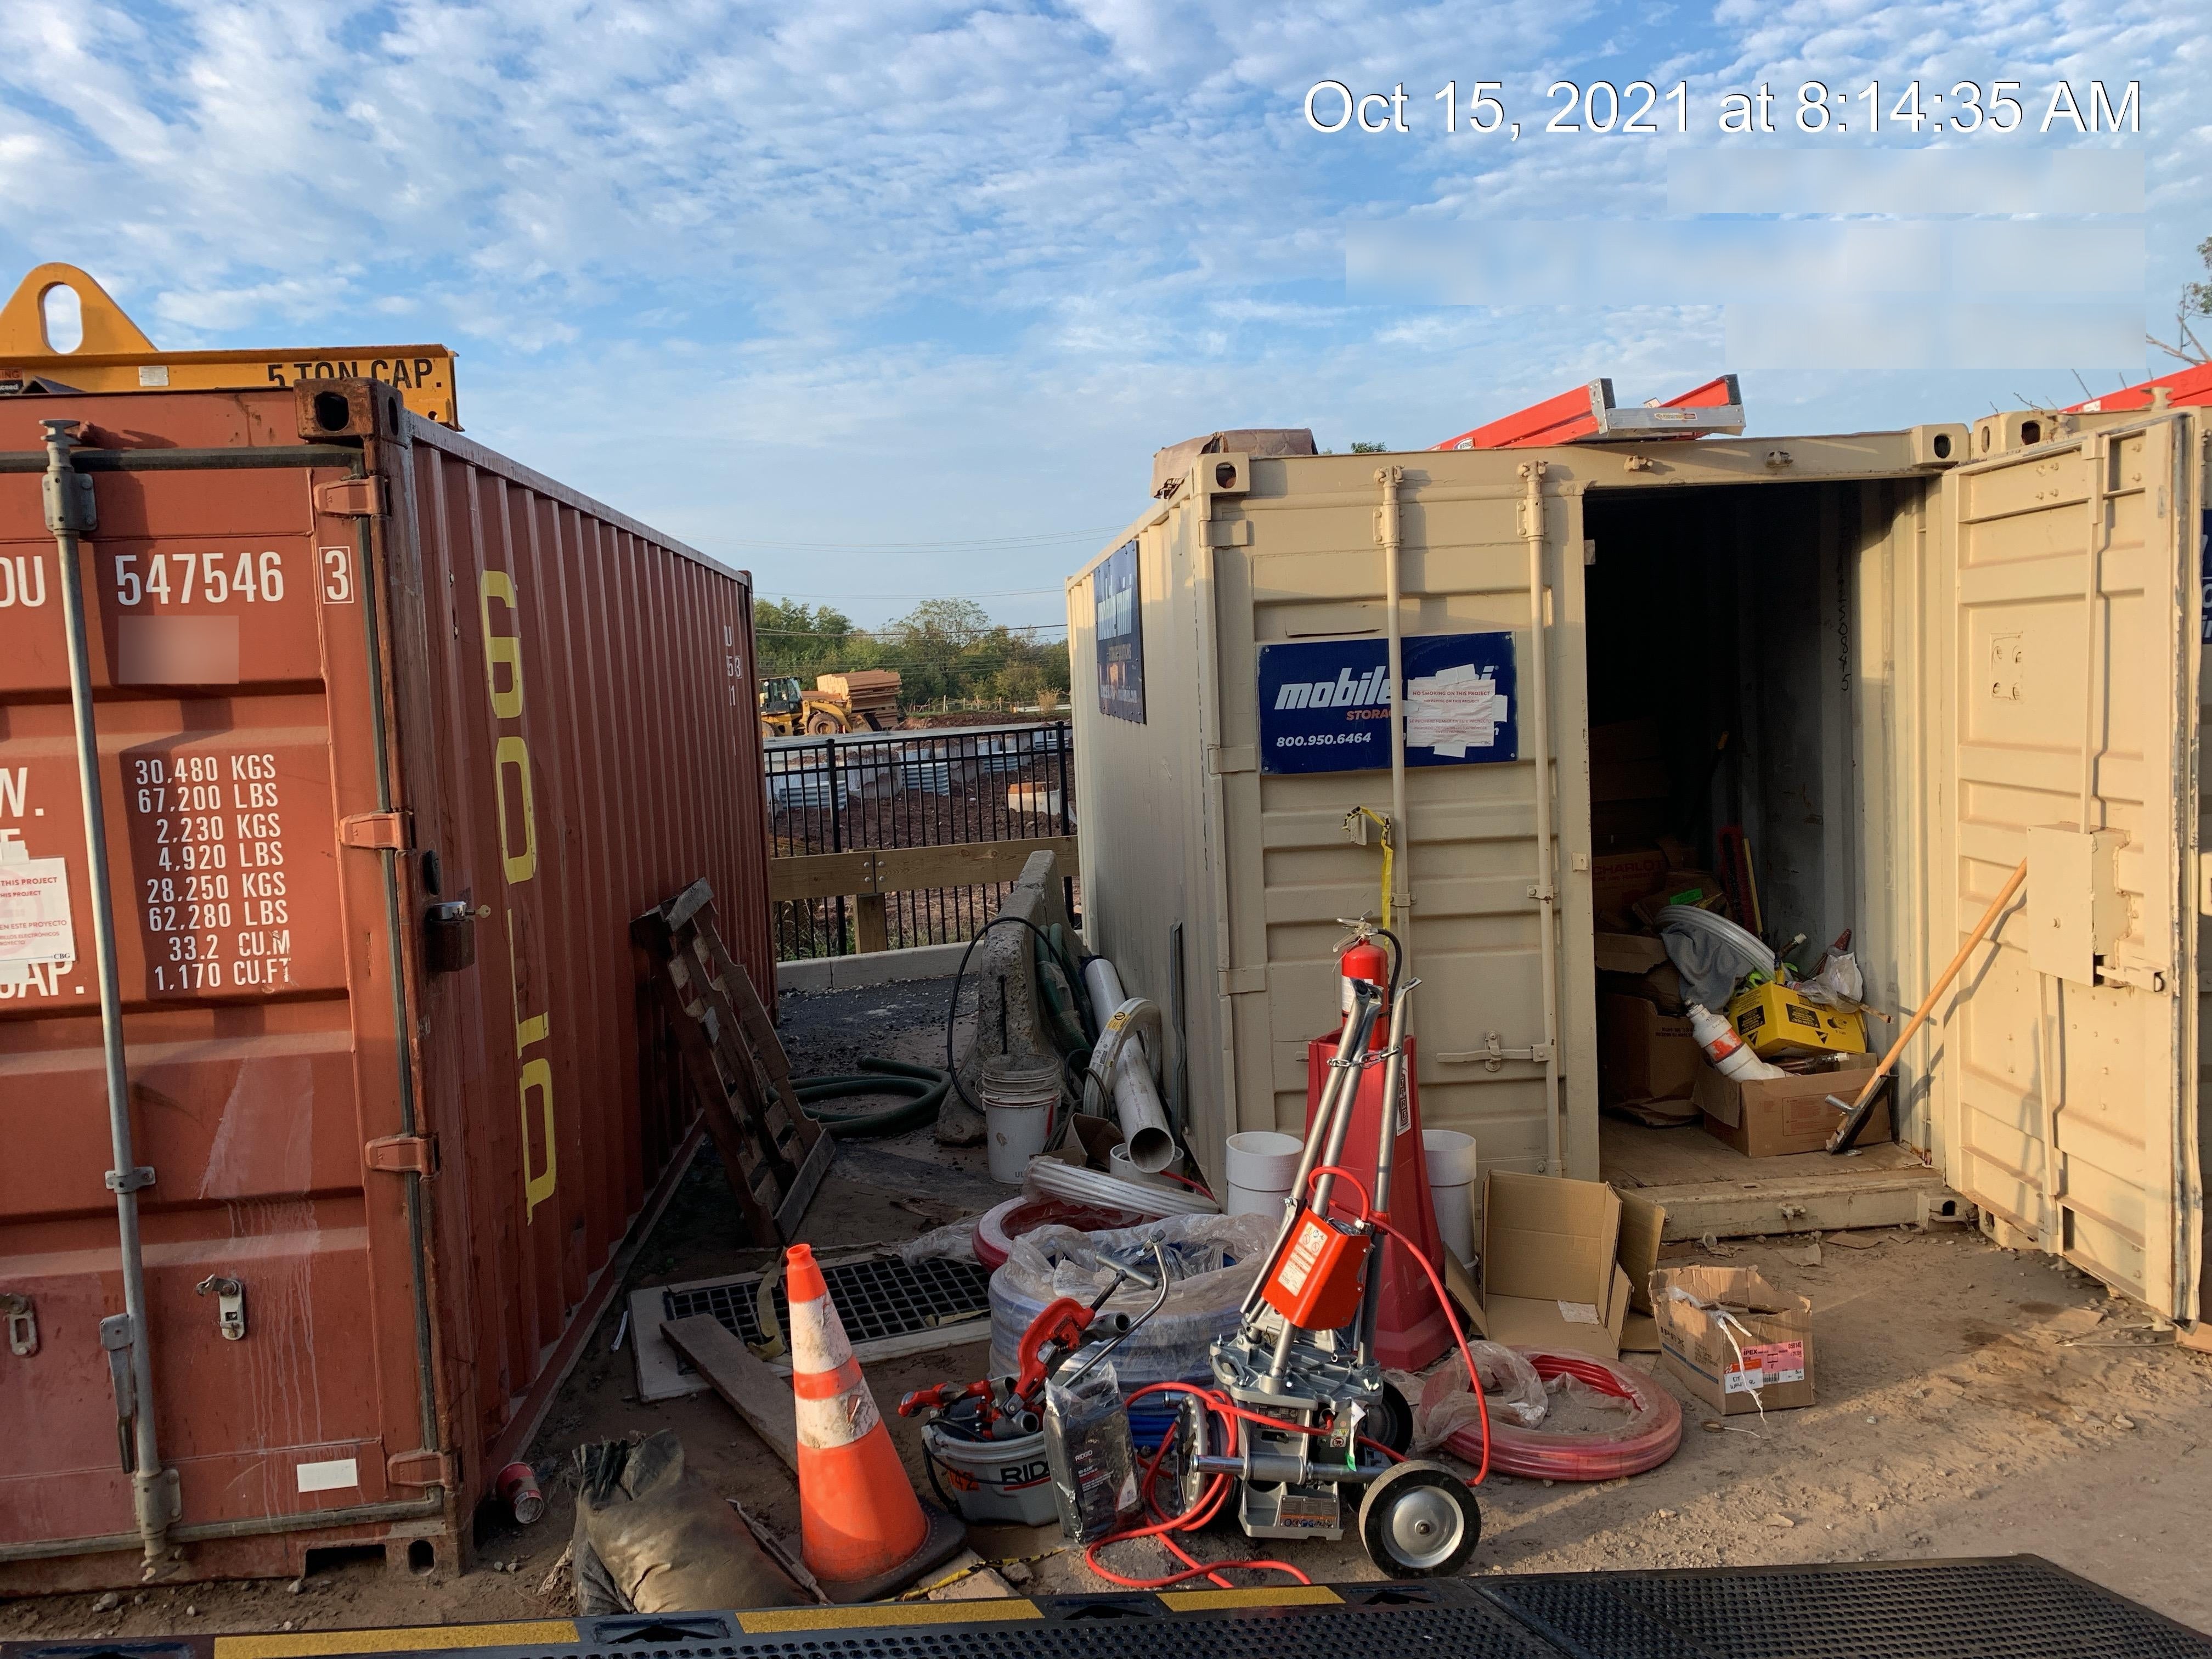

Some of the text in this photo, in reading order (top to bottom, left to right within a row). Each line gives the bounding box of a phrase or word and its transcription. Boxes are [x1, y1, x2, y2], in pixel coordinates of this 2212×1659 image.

[268, 364, 285, 387] 5
[371, 358, 441, 389] CAP.
[115, 551, 284, 606] 547546
[324, 549, 349, 601] 3
[1346, 708, 1391, 721] STORA
[1276, 732, 1372, 747] 800.950.6464
[135, 754, 276, 785] 30,480 KGS
[138, 782, 279, 814] 67,200 LBS
[156, 813, 281, 844] 2,230 KGS
[159, 841, 284, 872] 4,920 LBS
[1, 877, 58, 887] THIS PROJECT
[146, 871, 286, 904] 28,250 KGS
[149, 899, 289, 932] 62,280 LBS
[168, 929, 291, 961] 33.2 CU.M
[155, 958, 291, 991] 1,170 CU.FT
[1000, 1460, 1050, 1483] RID
